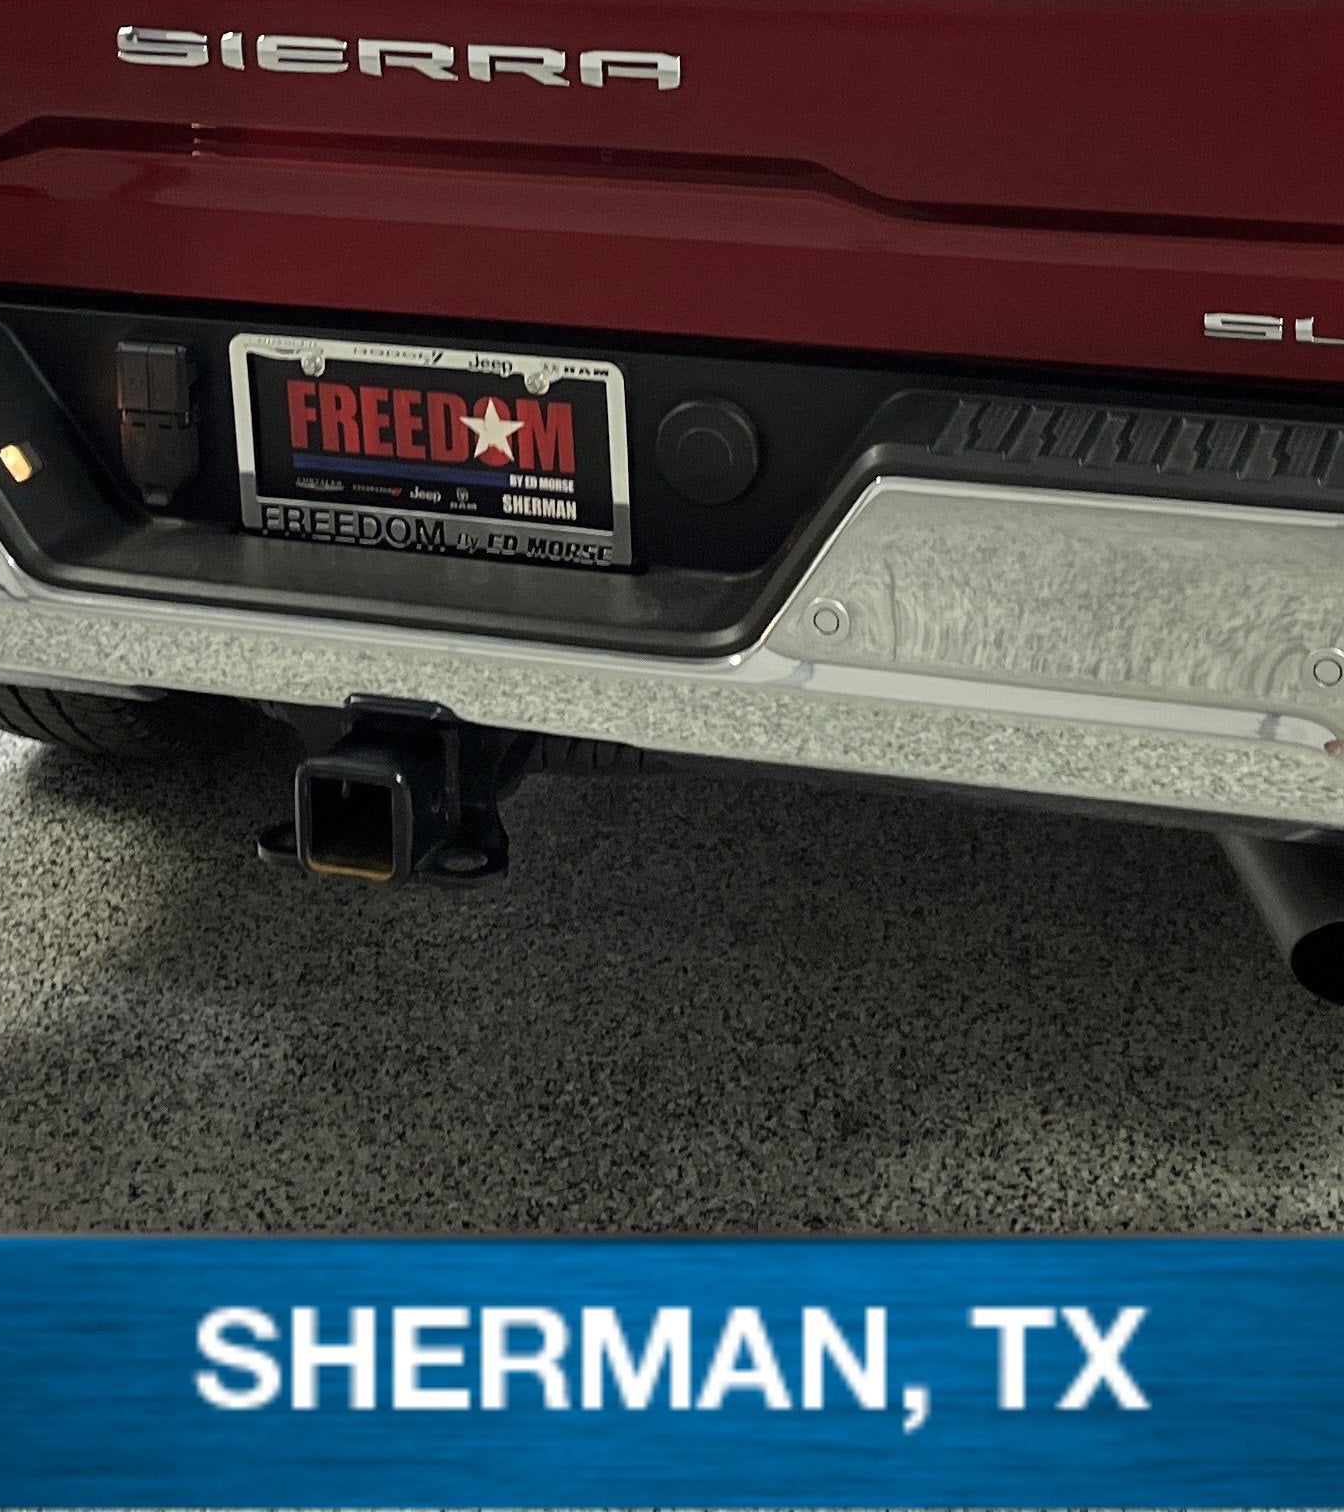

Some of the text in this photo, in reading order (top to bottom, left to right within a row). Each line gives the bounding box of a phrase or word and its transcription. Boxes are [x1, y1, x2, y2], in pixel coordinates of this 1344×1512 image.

[117, 25, 681, 90] SIERRA
[468, 353, 513, 377] Jeep
[287, 379, 576, 475] FREEDOM
[409, 485, 442, 505] Jeep
[509, 473, 523, 488] BY
[539, 476, 575, 494] MORSE
[502, 493, 577, 522] SHERMAN
[261, 505, 446, 552] FREEDOM
[487, 533, 519, 556] ED
[527, 537, 614, 567] MORSE
